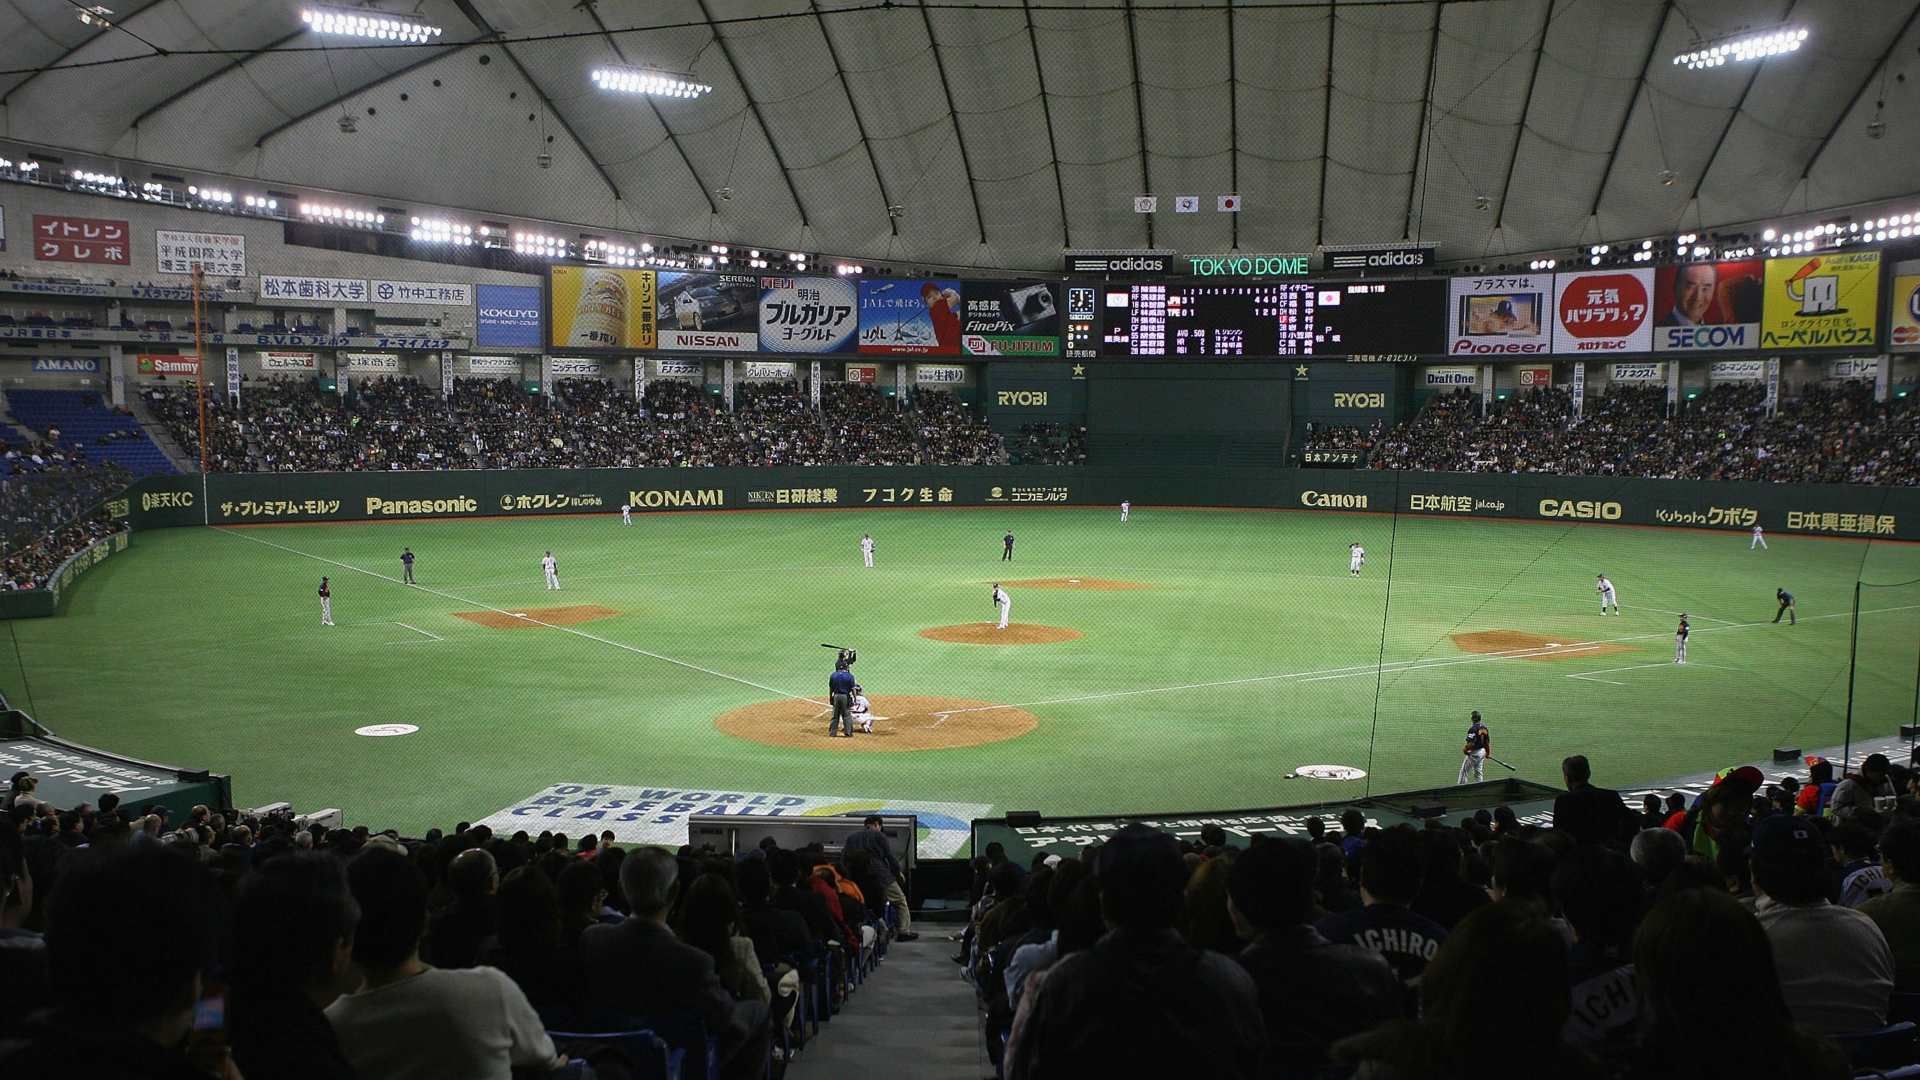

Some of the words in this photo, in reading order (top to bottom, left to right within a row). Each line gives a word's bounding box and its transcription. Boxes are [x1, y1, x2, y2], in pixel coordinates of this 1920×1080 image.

[41, 221, 122, 240] イトレン
[1110, 256, 1163, 272] adidas
[1190, 258, 1252, 277] TOKYO
[1255, 256, 1309, 275] DOME
[1369, 250, 1424, 268] adidas
[720, 274, 756, 283] SERENA
[264, 279, 365, 299] 松本歯科大学
[399, 287, 465, 301] 竹中工務店
[797, 288, 820, 300] 明治
[1587, 288, 1620, 305] 元気
[480, 308, 539, 318] KOKUYO
[766, 302, 851, 327] ブルガリア
[967, 300, 1001, 312] 高感度
[782, 327, 836, 342] ヨーグルト
[862, 326, 887, 343] JAL
[965, 320, 1016, 332] FinePix
[1067, 324, 1075, 332] S
[1325, 326, 1333, 334] P
[677, 335, 740, 347] NISSAN
[1576, 340, 1627, 350] オロナミンC
[1668, 326, 1744, 348] SECOM
[1762, 328, 1873, 345] ヘーベルハウス
[1452, 339, 1547, 354] Pioneer
[35, 359, 96, 372] AMANO
[154, 359, 199, 375] Sammy
[1427, 373, 1453, 384] Draft
[1454, 374, 1475, 384] One
[997, 391, 1048, 406] RYOBI
[1333, 392, 1385, 408] RYOBI
[1304, 451, 1359, 463] 日本アンテナ
[151, 491, 194, 508] 楽天KC
[516, 494, 570, 509] ホクレン
[629, 489, 724, 508] KONAMI
[776, 488, 838, 504] 日研総業
[862, 486, 954, 503] フコク生命
[1011, 493, 1068, 502] コニカミノルタ
[1301, 490, 1368, 509] Canon
[220, 499, 341, 517] ザ・プレミアム・モルツ
[366, 495, 478, 515] Panasonic
[1410, 494, 1472, 513] 日本航空
[1474, 499, 1505, 512] jal.co.jp
[1539, 499, 1622, 520] CASIO
[1707, 507, 1758, 527] クボタ
[1787, 511, 1896, 535] 日本興亜損保
[530, 795, 788, 817] BASEBALL
[638, 788, 808, 807] WORLD
[510, 806, 682, 824] CLASS
[1853, 868, 1883, 890] ICHI
[1352, 927, 1440, 962] ICHIRO
[1573, 976, 1630, 1027] ICH
